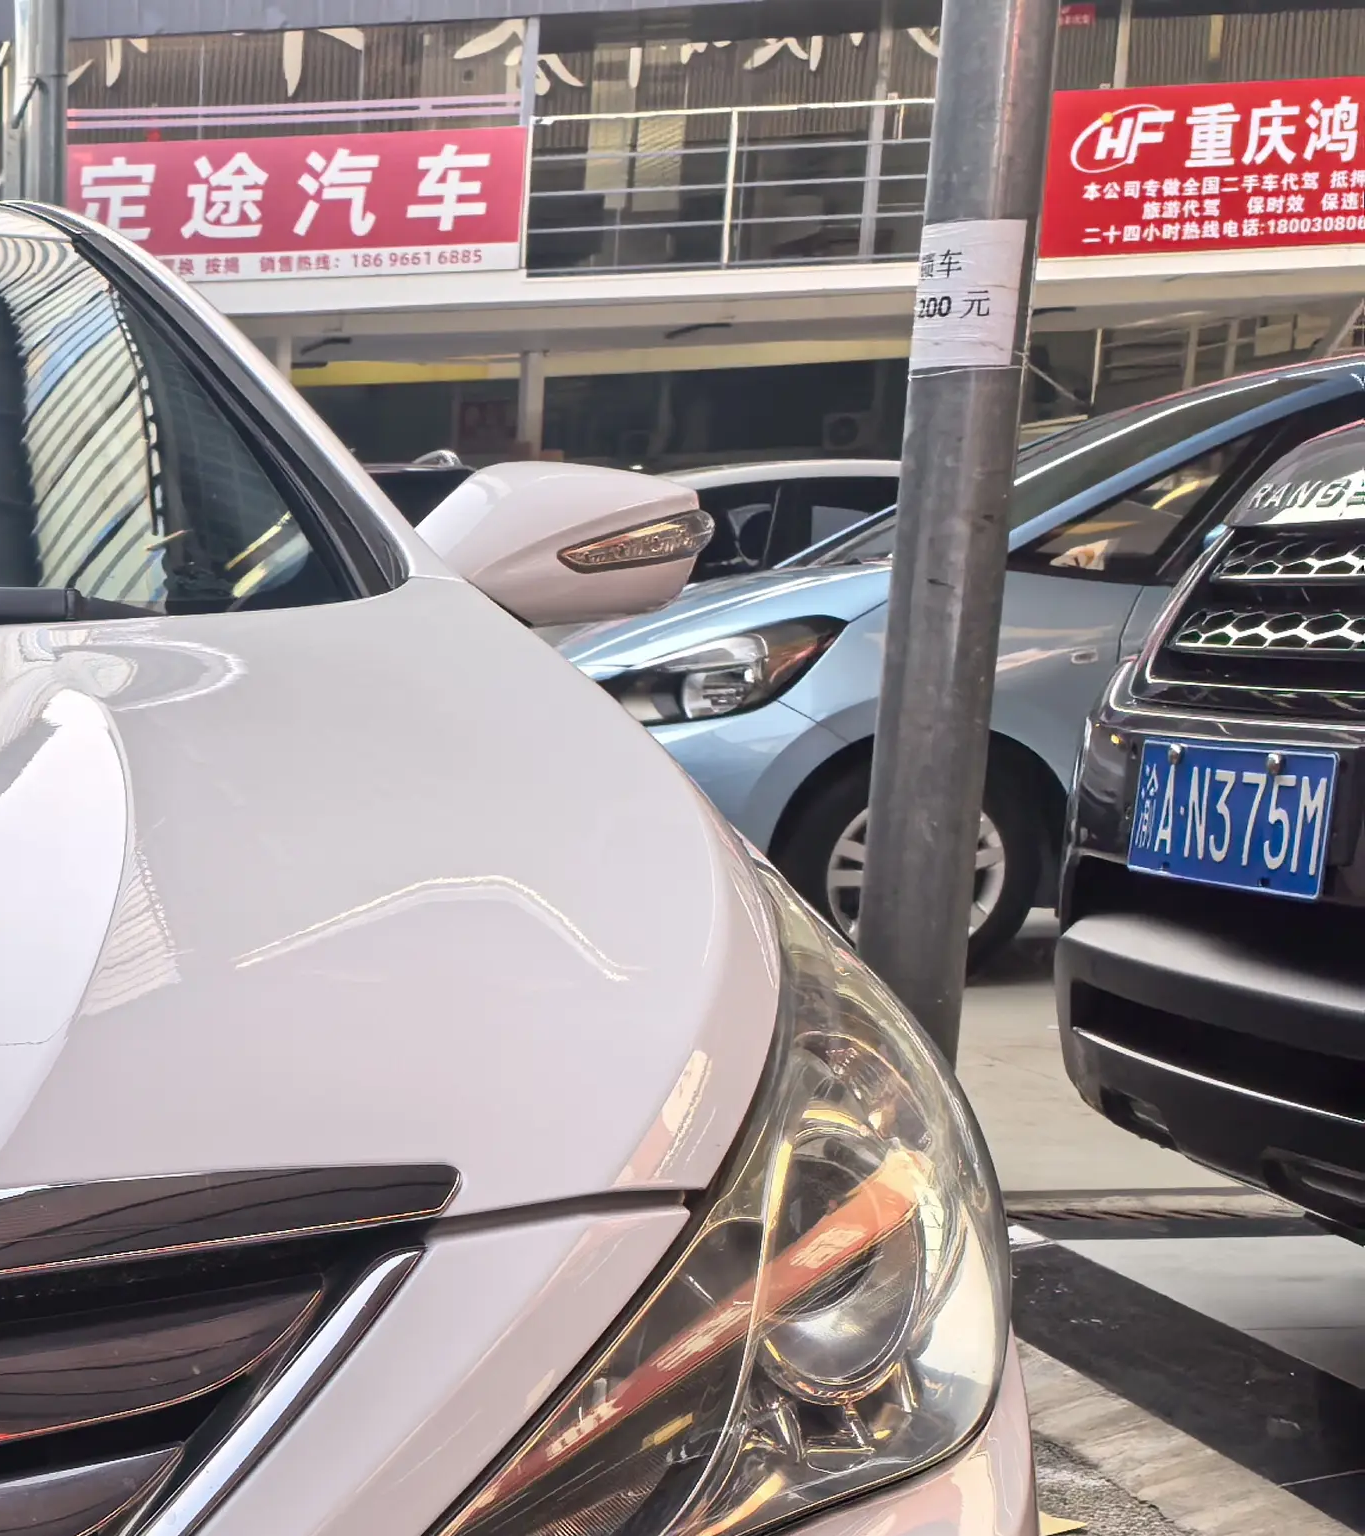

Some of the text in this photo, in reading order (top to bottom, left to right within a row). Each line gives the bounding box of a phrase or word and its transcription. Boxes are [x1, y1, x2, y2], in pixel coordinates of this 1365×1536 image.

[1183, 95, 1360, 168] 重庆鸿
[80, 143, 491, 241] 定途汽车
[1082, 171, 1320, 201] 本公司专做全国二手车代驾
[1141, 198, 1221, 220] 旅游代驾
[1246, 193, 1306, 215] 保时效
